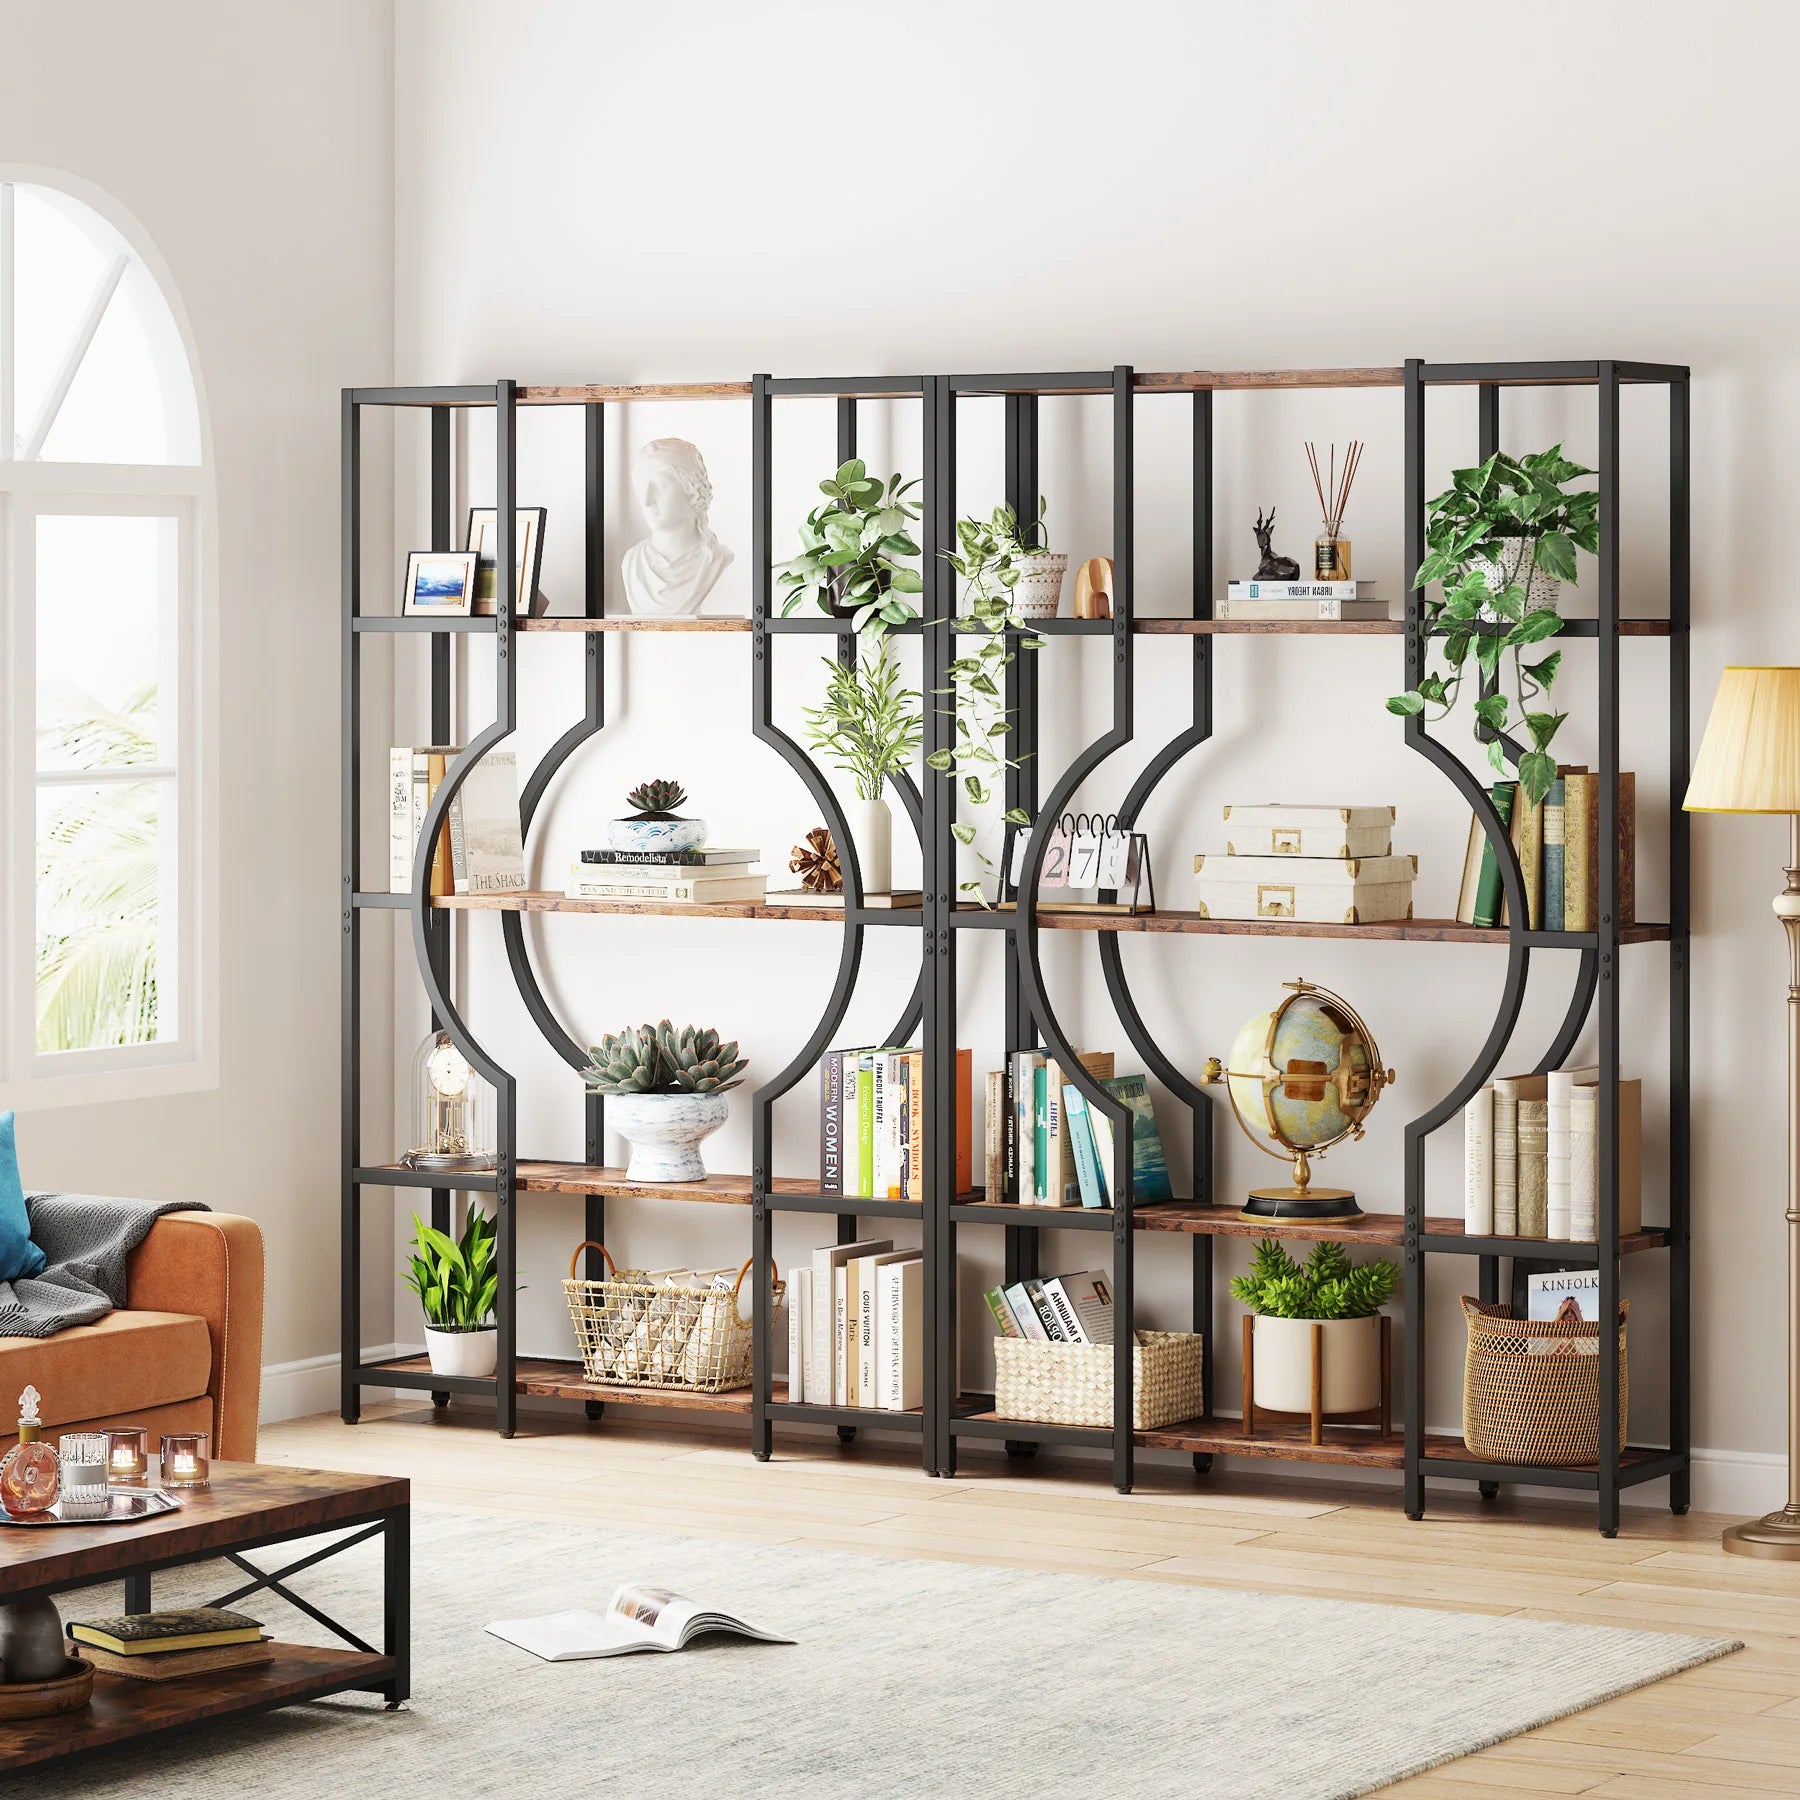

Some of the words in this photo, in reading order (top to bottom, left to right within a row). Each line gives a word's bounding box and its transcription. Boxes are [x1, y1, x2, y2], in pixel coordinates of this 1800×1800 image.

[450, 815, 461, 834] THE
[453, 836, 464, 867] SHACK
[614, 851, 667, 864] Remodelista
[1045, 846, 1065, 878] 2
[1078, 848, 1095, 880] 7
[473, 874, 493, 889] THE
[495, 872, 526, 888] SHACK
[830, 1057, 838, 1102] MODERN
[862, 1086, 870, 1120] Ecological
[912, 1089, 920, 1118] BOOK
[825, 1105, 838, 1178] WOMEN
[862, 1121, 870, 1145] Design
[912, 1129, 920, 1181] SYMBOLS
[1542, 1277, 1599, 1292] KINFOLK
[849, 1319, 857, 1342] Paris
